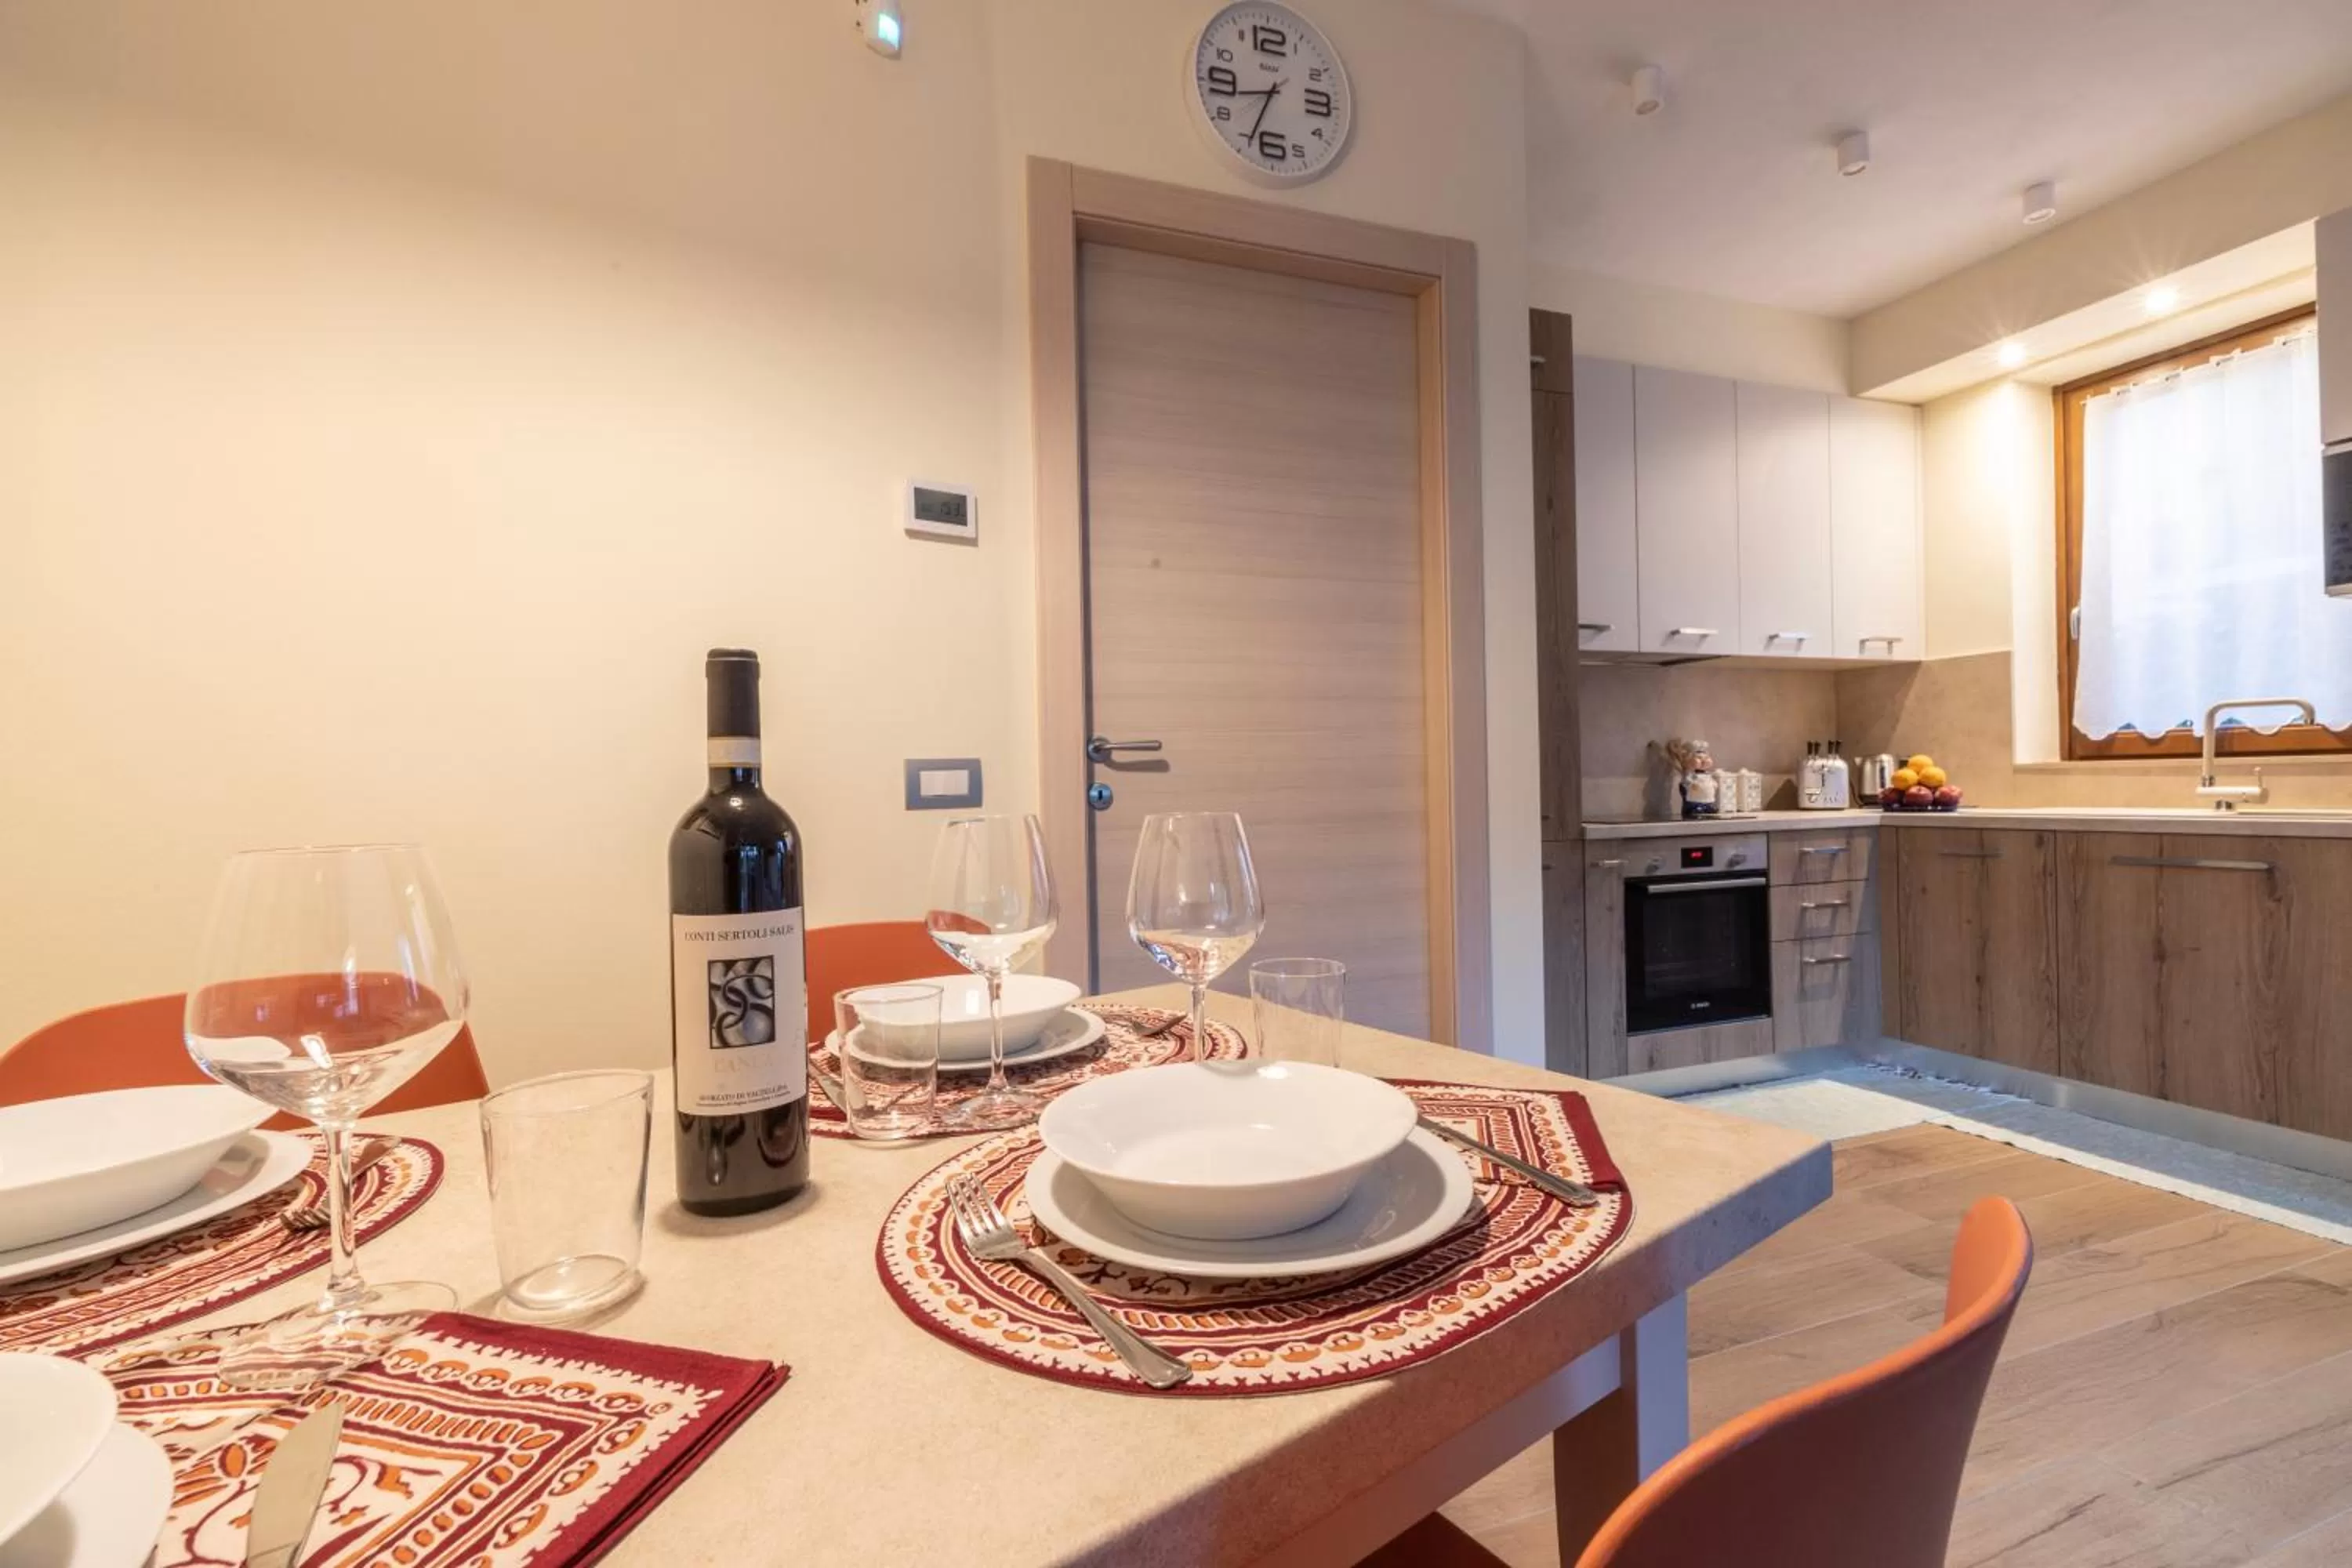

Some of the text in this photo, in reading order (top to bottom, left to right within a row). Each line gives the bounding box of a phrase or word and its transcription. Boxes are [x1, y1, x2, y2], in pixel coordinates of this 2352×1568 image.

[1252, 24, 1287, 57] 12
[1217, 48, 1233, 63] 10
[1208, 66, 1236, 96] 9
[1308, 67, 1322, 82] 2
[1304, 88, 1331, 117] 3
[1217, 106, 1231, 122] 8
[1311, 128, 1323, 140] 4
[1259, 130, 1287, 162] 6
[1292, 143, 1305, 158] 5
